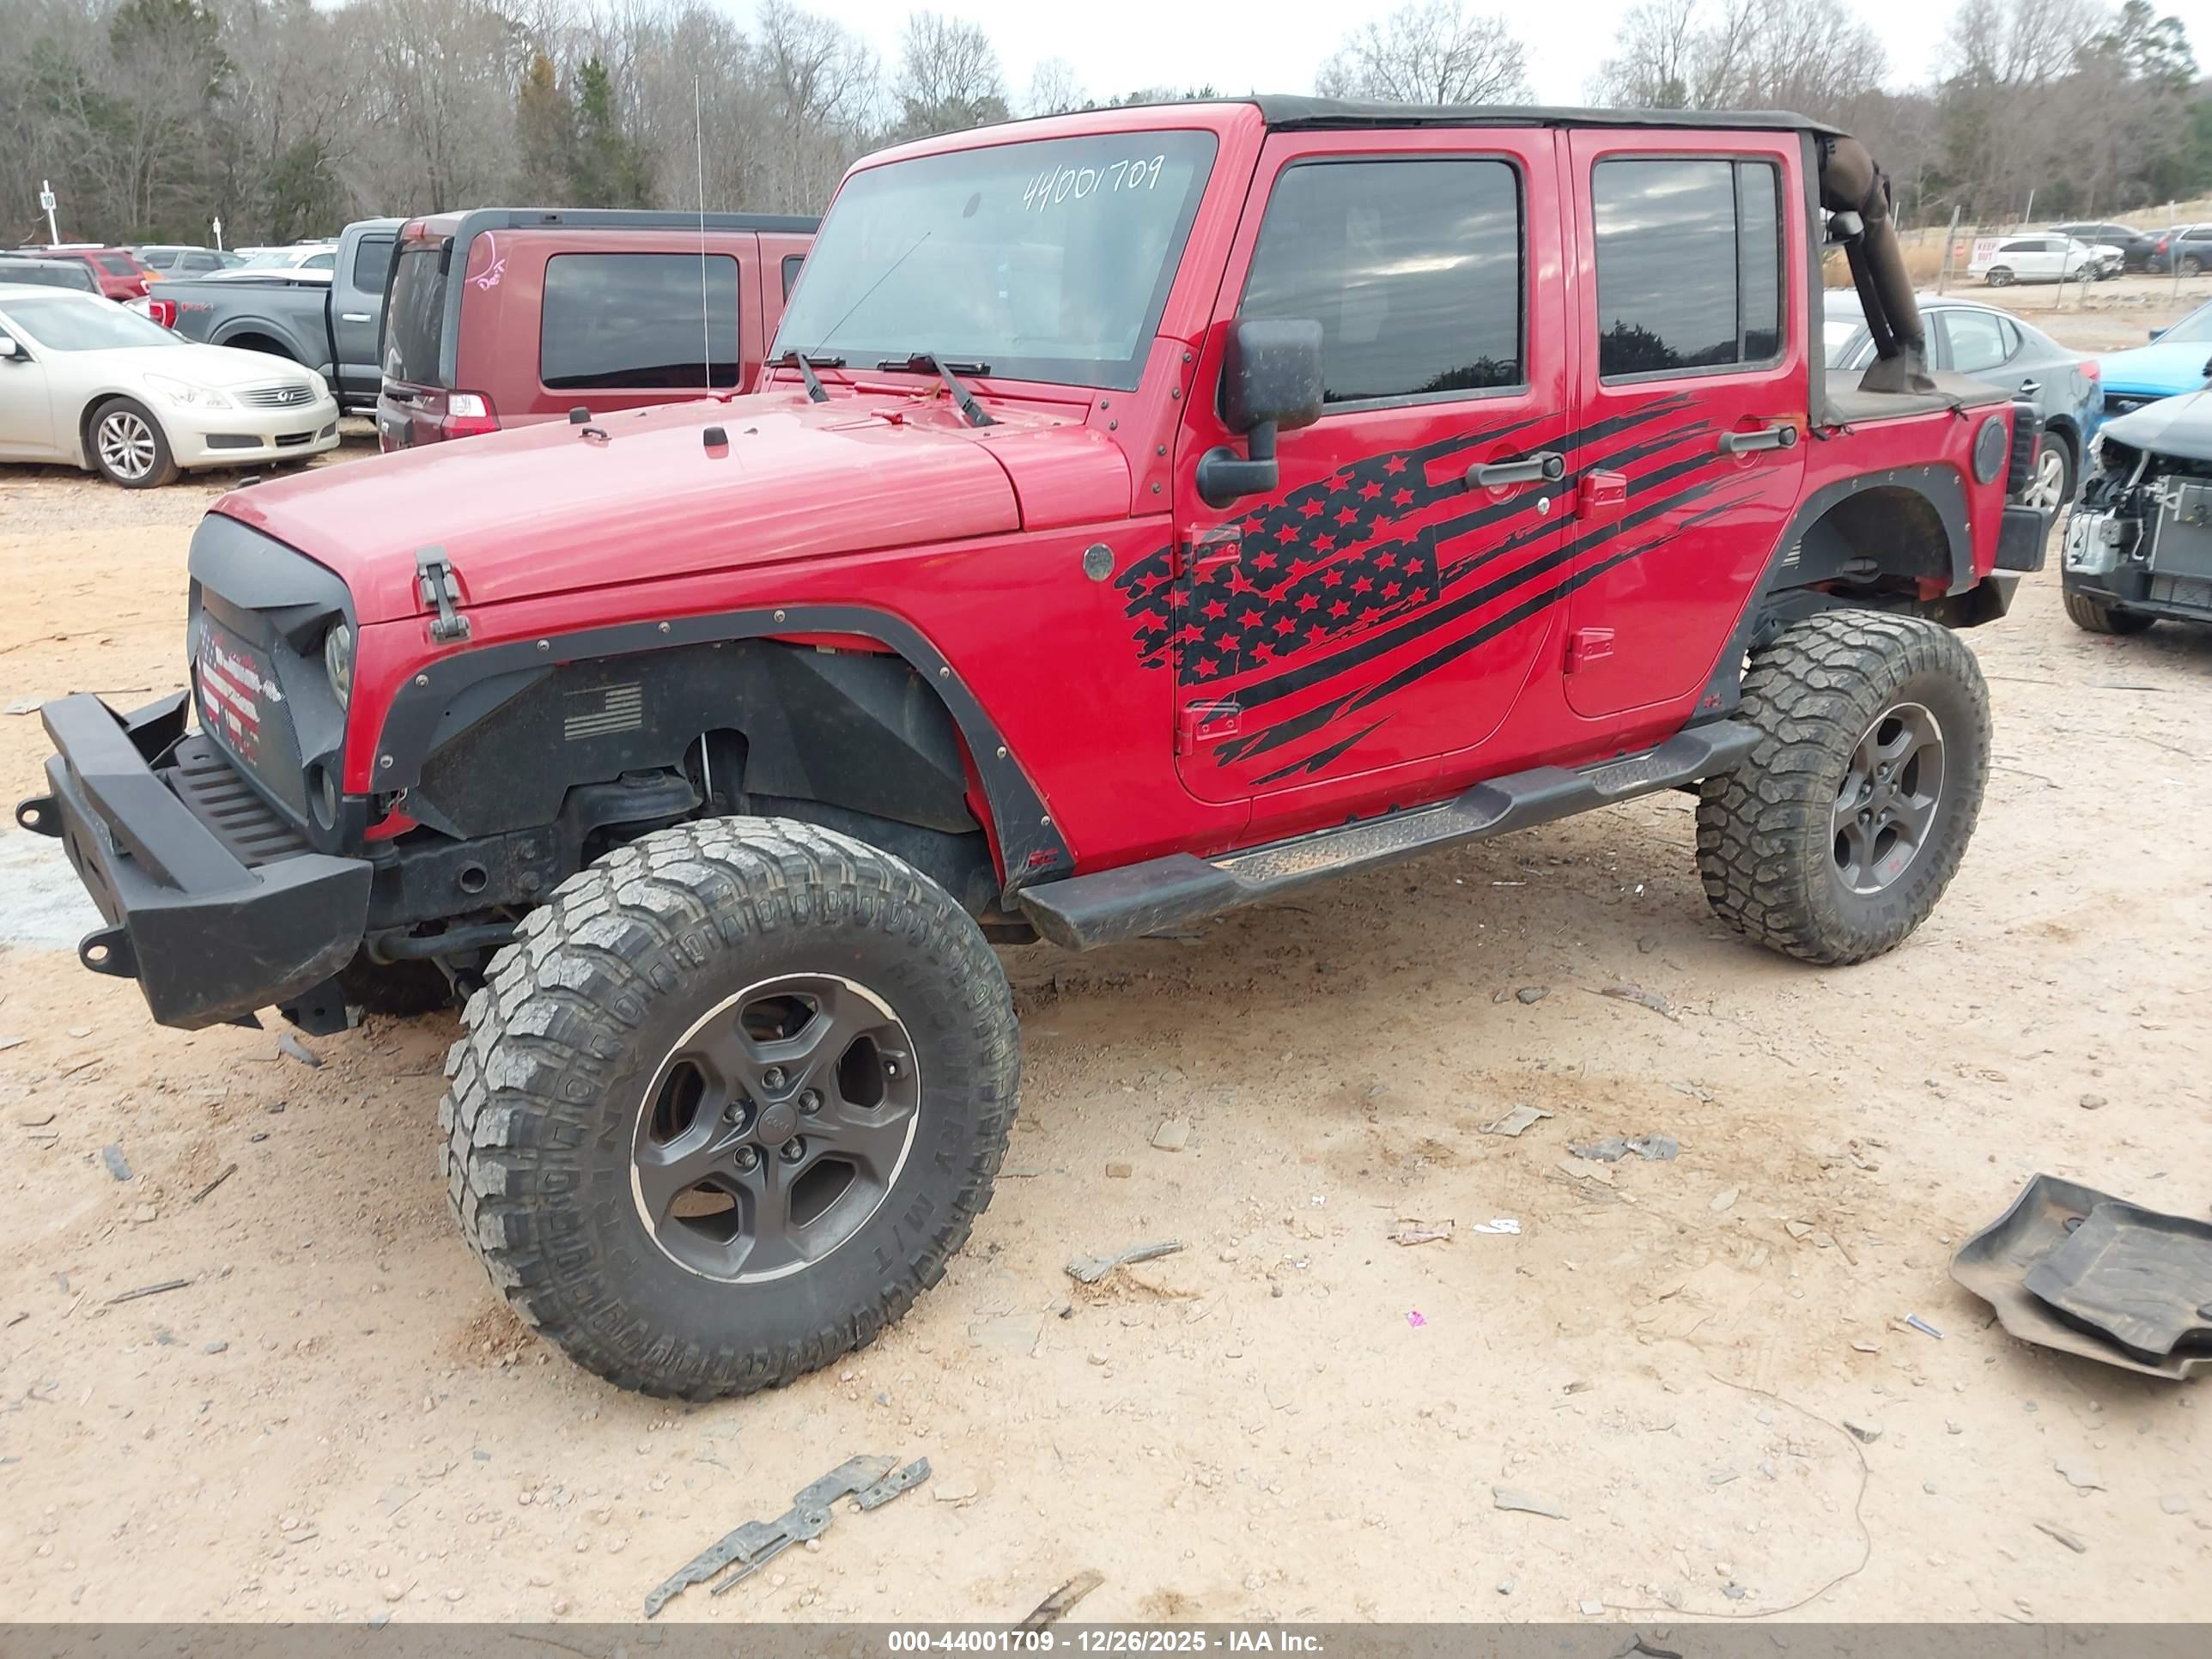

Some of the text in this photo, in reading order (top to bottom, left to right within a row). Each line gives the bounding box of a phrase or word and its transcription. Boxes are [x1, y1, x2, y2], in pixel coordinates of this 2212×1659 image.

[1024, 155, 1165, 213] 44001709
[43, 195, 54, 207] 10
[1978, 241, 1998, 252] KEEP
[1978, 252, 1993, 261] OUT
[872, 1192, 935, 1276] M/T
